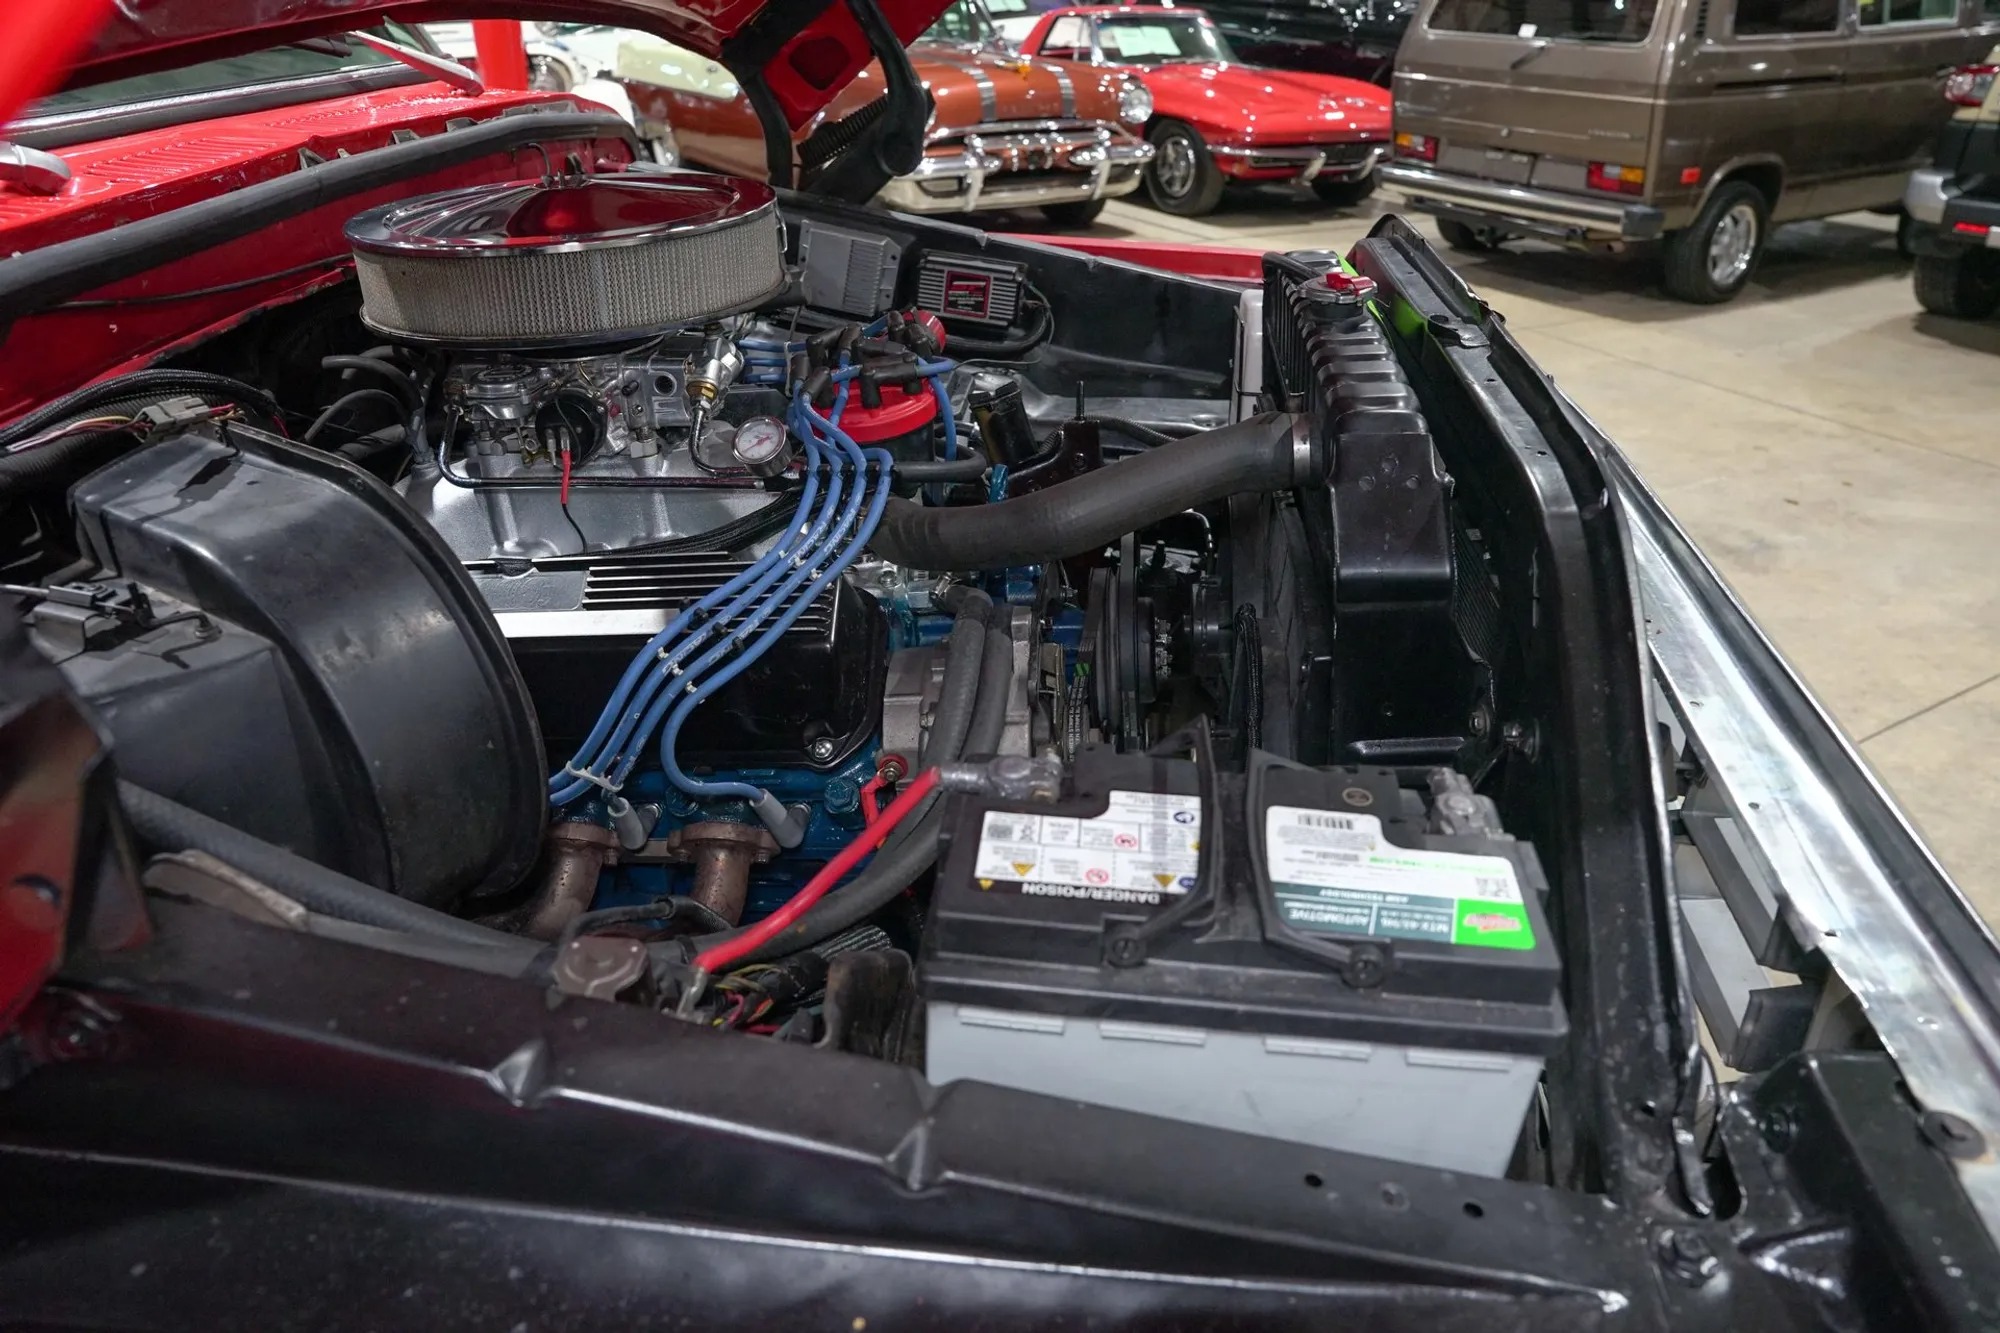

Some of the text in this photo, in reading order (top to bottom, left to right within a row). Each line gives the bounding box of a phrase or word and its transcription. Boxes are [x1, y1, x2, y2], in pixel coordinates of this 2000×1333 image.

[823, 508, 856, 556] RACING
[1021, 882, 1160, 904] DANGER/POISON
[1288, 908, 1370, 926] AUTOMOTIVE
